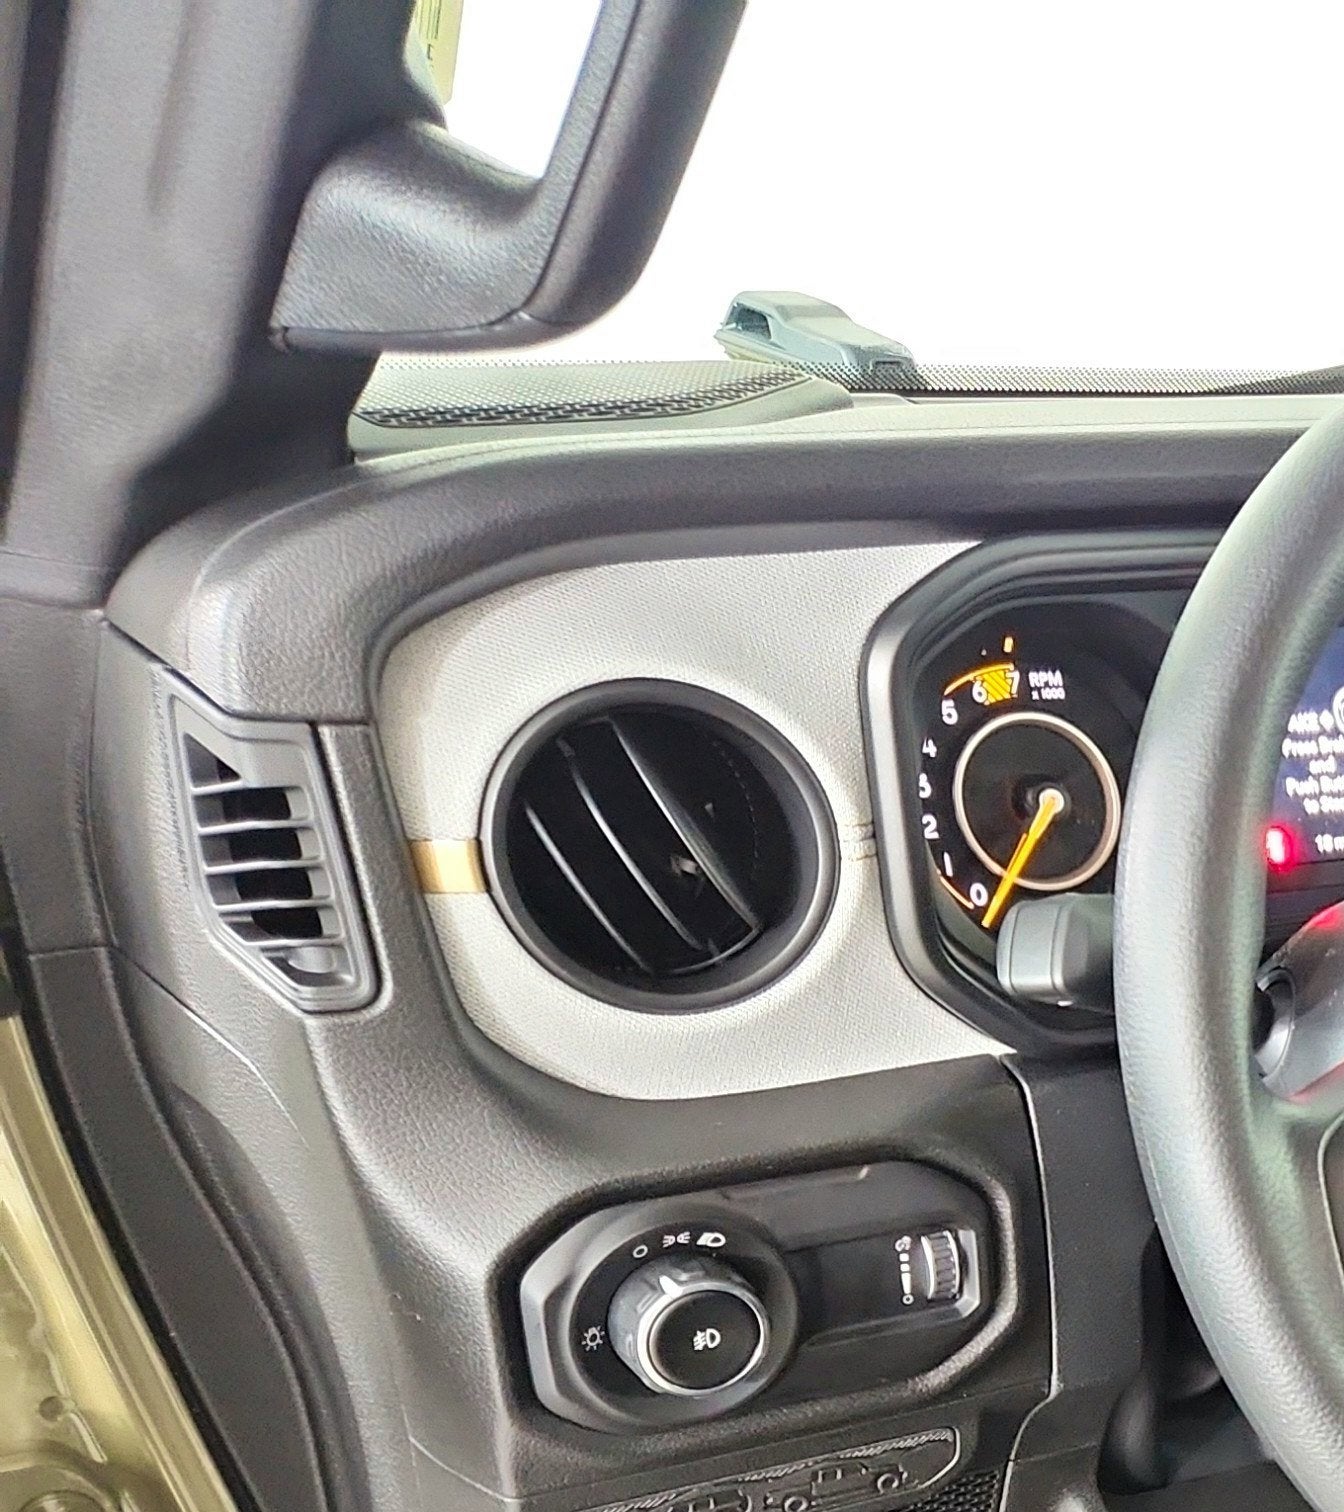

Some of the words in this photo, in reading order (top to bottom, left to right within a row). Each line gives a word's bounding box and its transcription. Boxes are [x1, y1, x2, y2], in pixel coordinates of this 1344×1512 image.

[1009, 672, 1019, 696] 7
[1029, 670, 1063, 687] RPM
[973, 680, 987, 702] 6
[942, 699, 957, 724] 5
[923, 738, 937, 757] 4
[1309, 755, 1337, 774] and
[919, 775, 931, 798] 3
[1286, 775, 1319, 798] Push
[1303, 797, 1319, 814] to
[922, 815, 938, 839] 2
[943, 852, 952, 876] 1
[970, 883, 988, 906] 0
